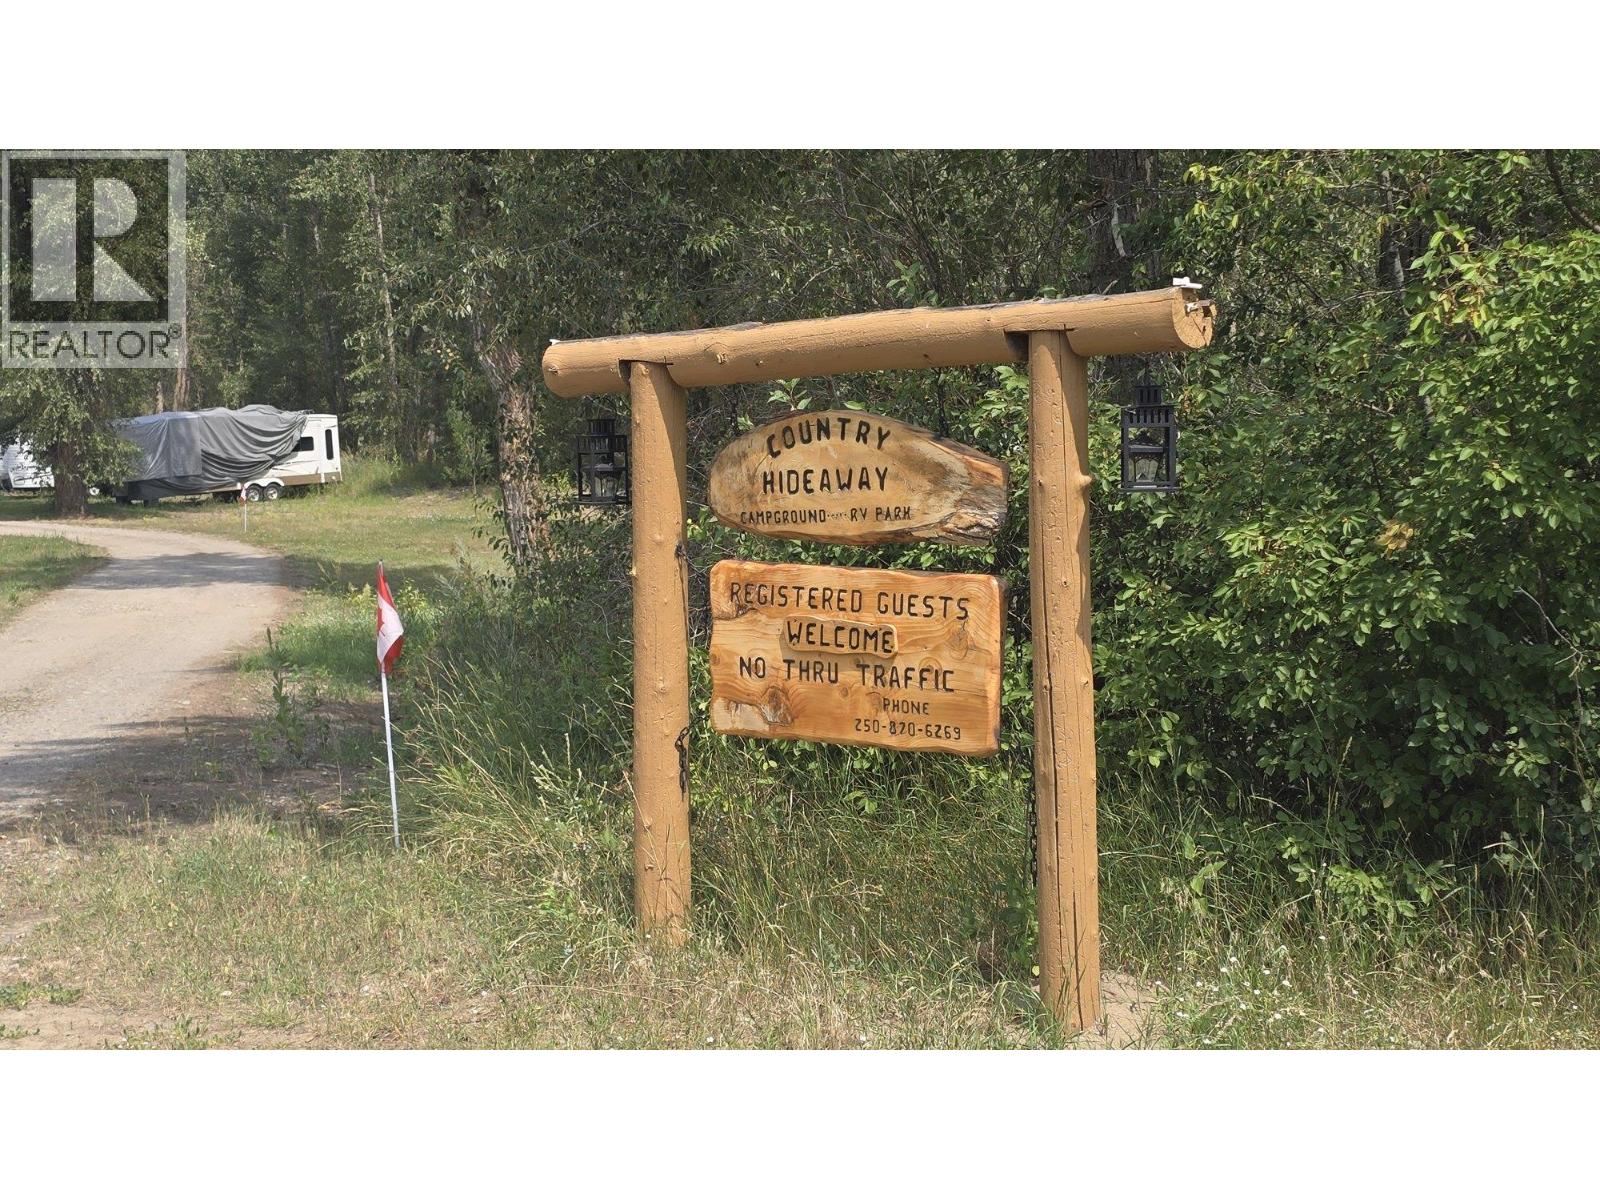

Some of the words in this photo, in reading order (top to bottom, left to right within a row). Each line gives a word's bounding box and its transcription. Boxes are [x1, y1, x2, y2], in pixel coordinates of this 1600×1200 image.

[766, 417, 891, 459] COUNTRY
[762, 466, 888, 495] HIDEAWAY
[740, 509, 826, 525] CAMPGROUND
[850, 507, 867, 522] RV
[875, 506, 912, 521] PARK
[730, 582, 863, 613] REGISTERED
[877, 591, 969, 621] GUESTS
[787, 619, 894, 654] WELCOME
[739, 656, 766, 679] NO
[782, 658, 839, 684] THRU
[856, 663, 955, 692] TRAFFIC
[882, 697, 930, 715] PHONE
[855, 718, 961, 740] 250-820-6269
